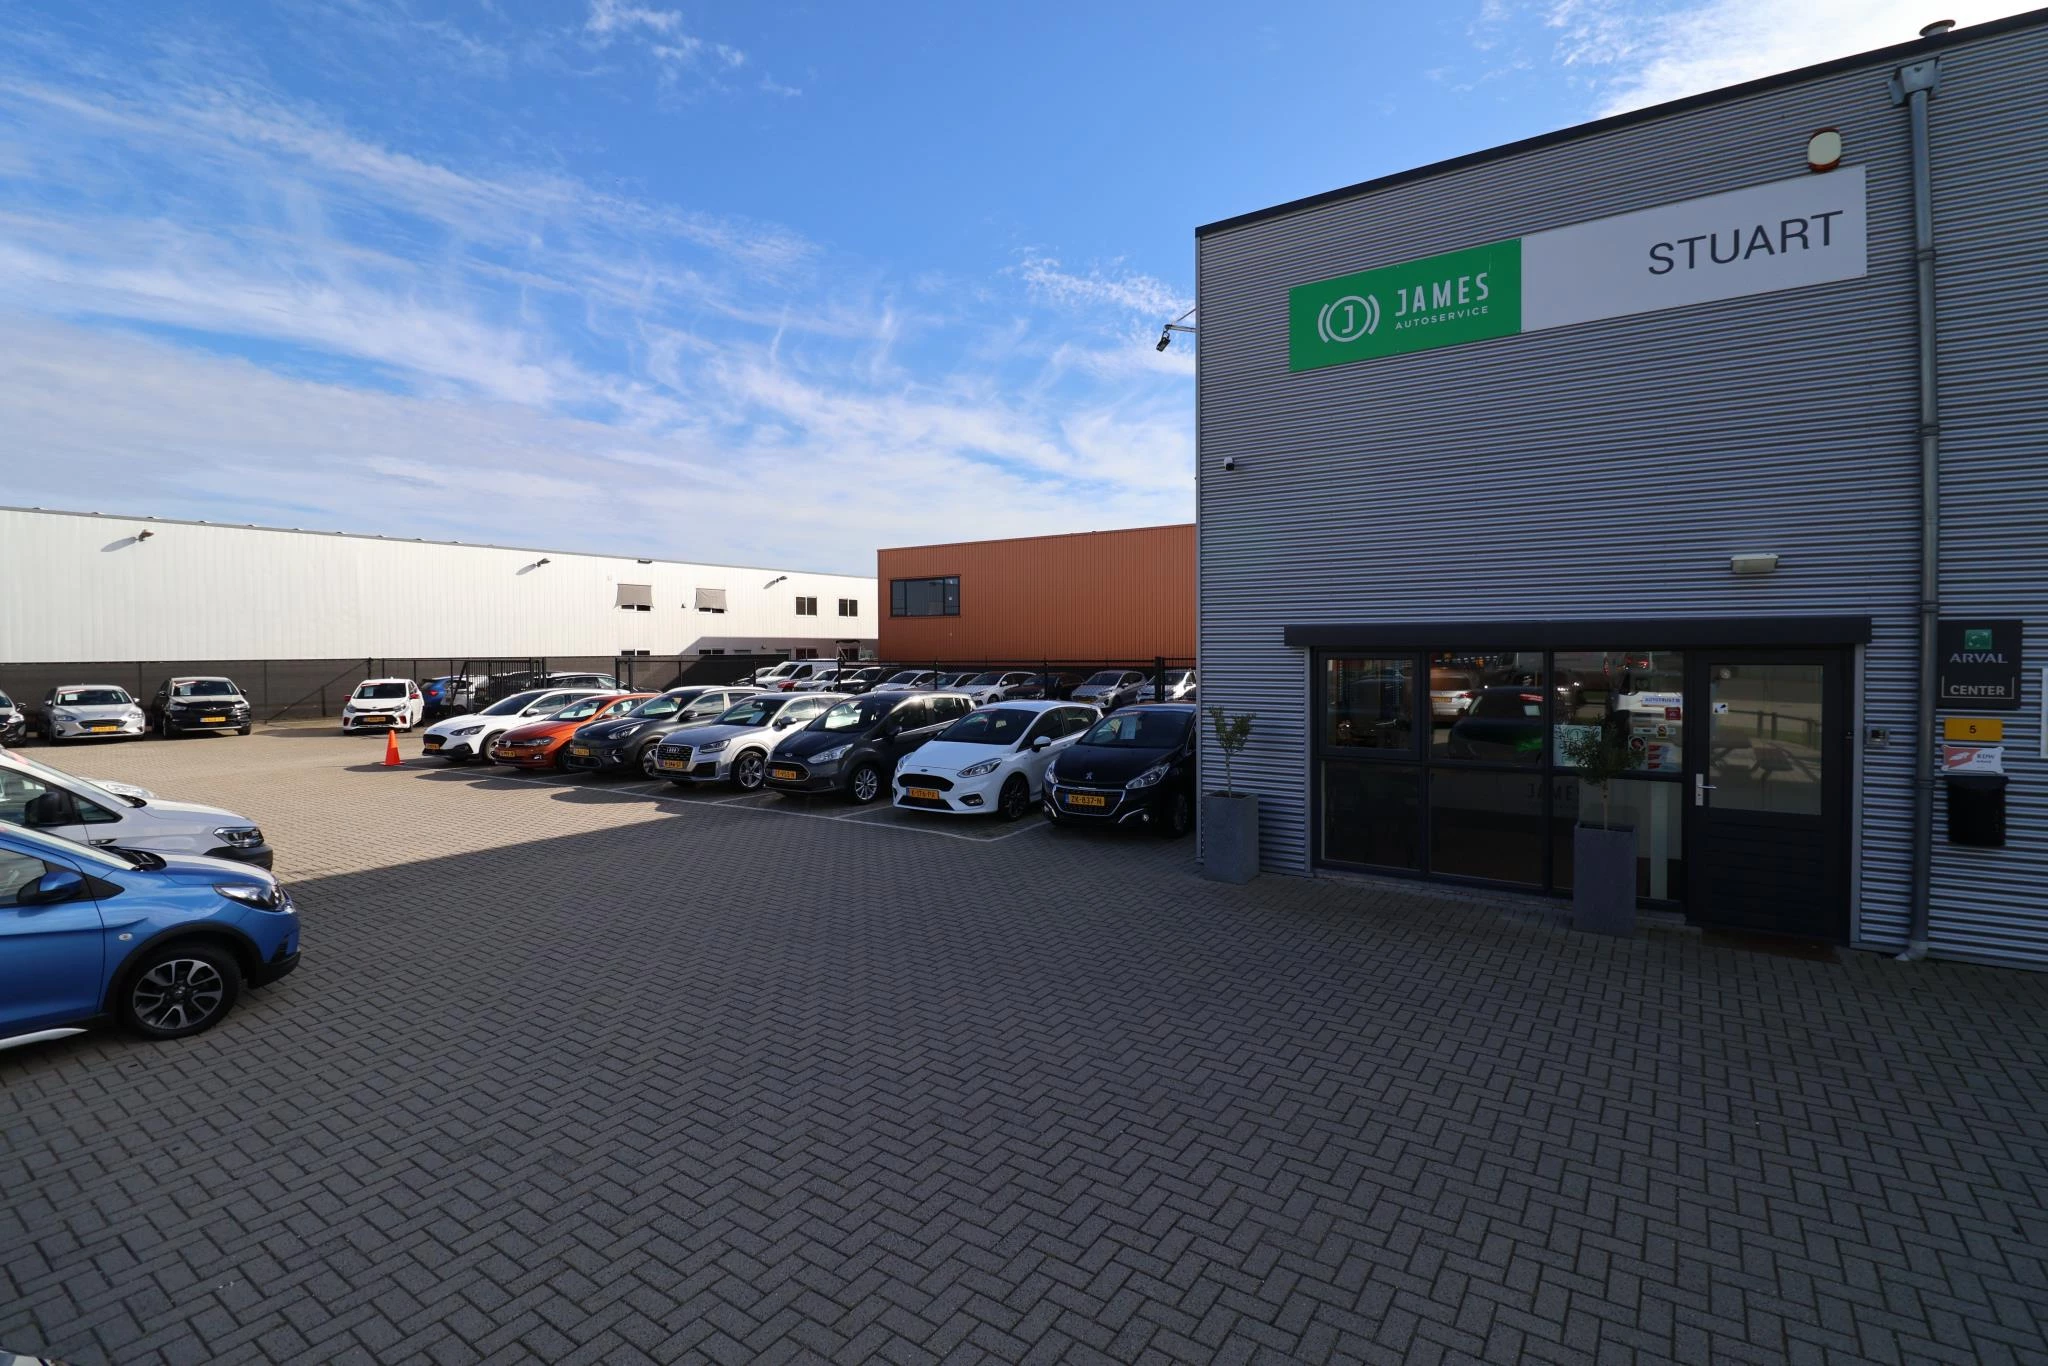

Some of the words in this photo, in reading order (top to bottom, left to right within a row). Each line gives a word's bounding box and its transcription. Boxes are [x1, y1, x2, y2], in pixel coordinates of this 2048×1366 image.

[1648, 209, 1844, 275] STUART
[1395, 272, 1489, 317] JAMES
[1394, 305, 1489, 330] AUTOSERVICE
[1949, 652, 2009, 664] ARVAL
[1950, 684, 2005, 696] CENTER
[1969, 724, 1977, 734] 5
